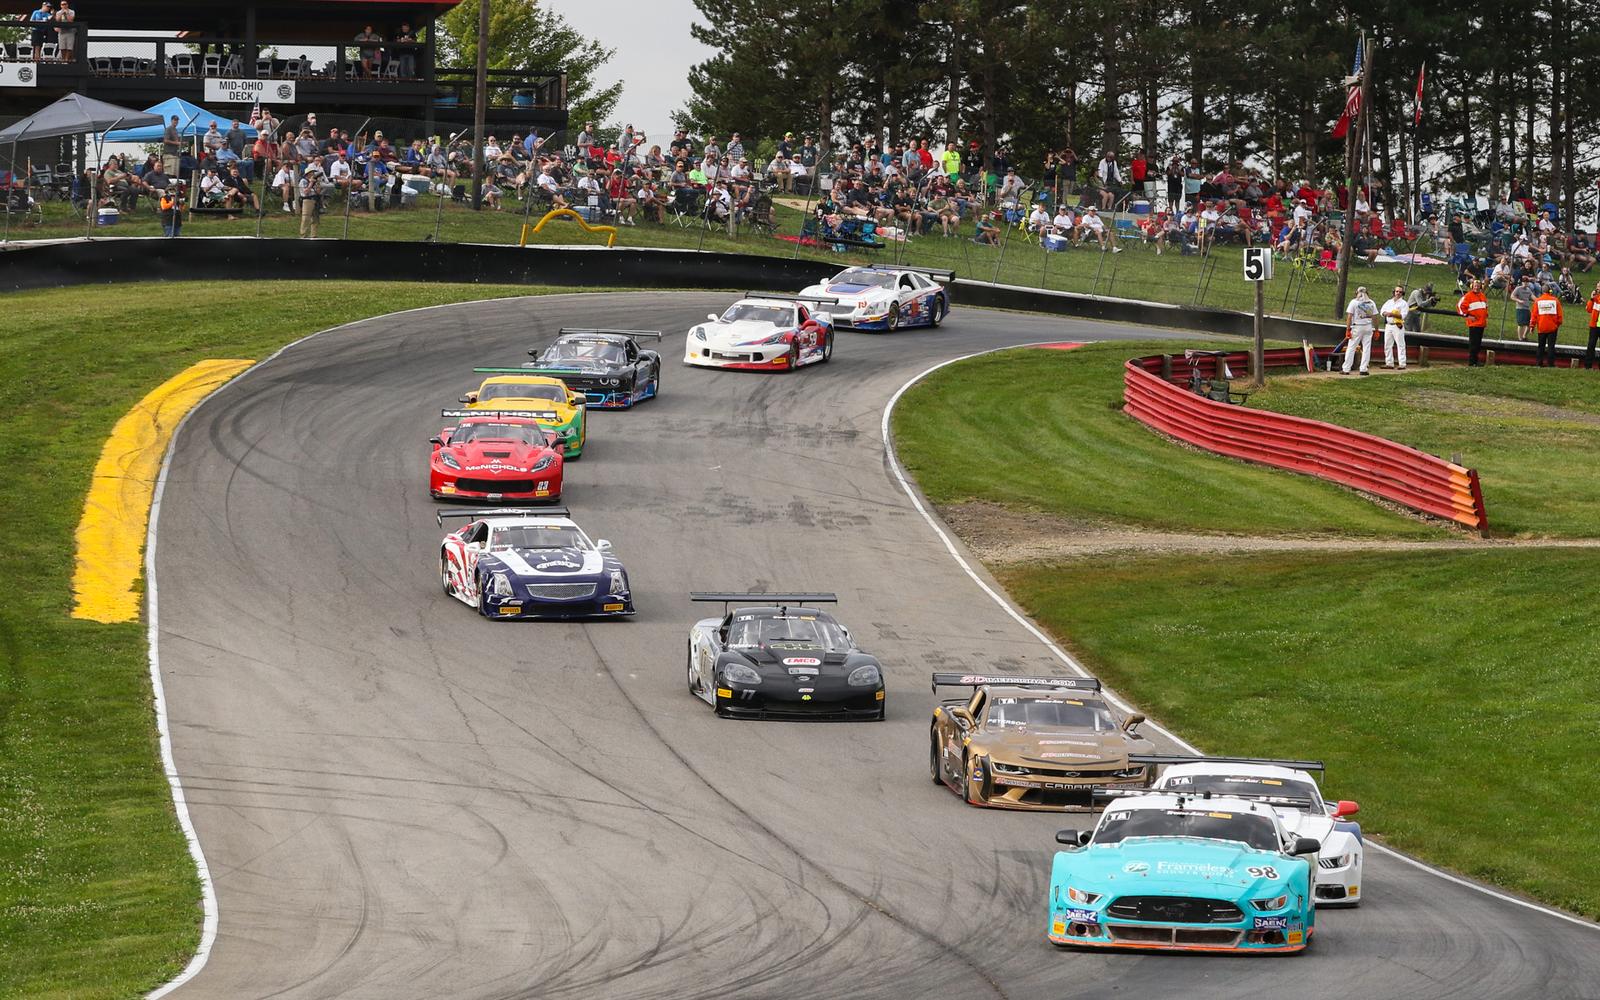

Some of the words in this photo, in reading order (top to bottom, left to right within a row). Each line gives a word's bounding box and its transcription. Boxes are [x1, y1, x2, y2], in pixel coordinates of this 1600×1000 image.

[219, 81, 264, 91] MID-OHIO
[229, 91, 254, 101] DECK
[1245, 248, 1263, 280] 5
[987, 718, 1027, 726] PETERSON
[1174, 777, 1191, 785] TA
[1109, 811, 1130, 820] TA
[1247, 866, 1280, 879] 98
[1066, 909, 1097, 922] SAENZ
[1254, 918, 1287, 928] SAENZ
